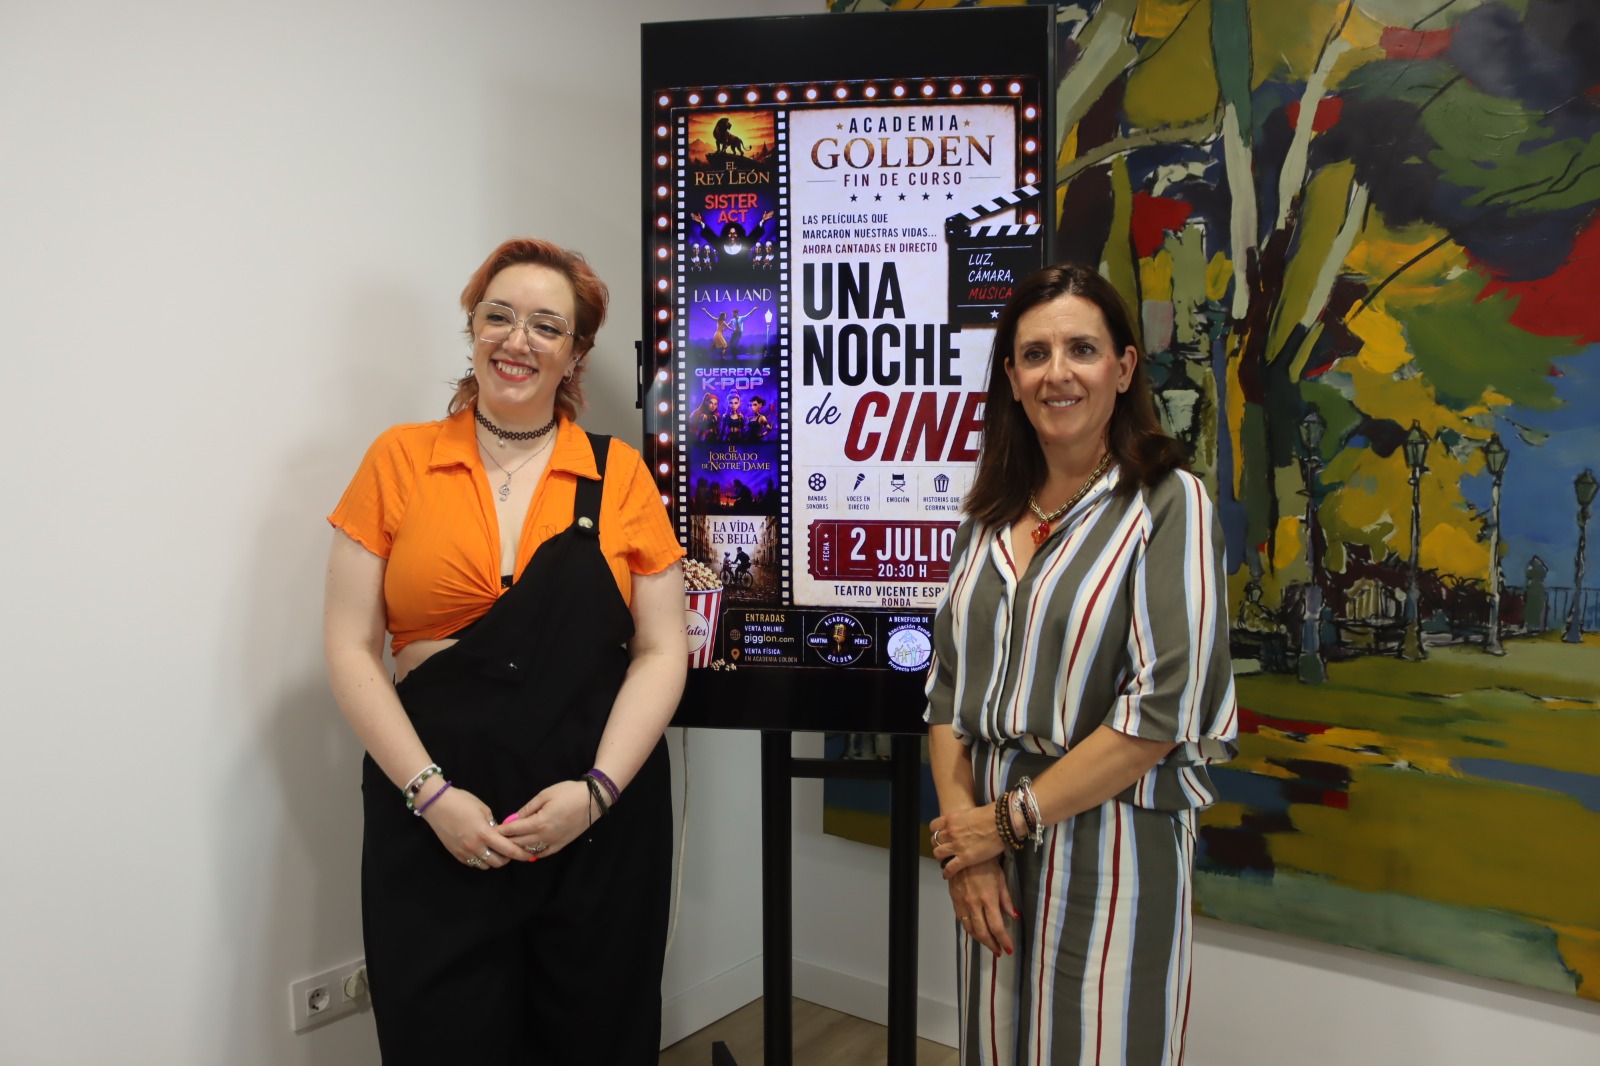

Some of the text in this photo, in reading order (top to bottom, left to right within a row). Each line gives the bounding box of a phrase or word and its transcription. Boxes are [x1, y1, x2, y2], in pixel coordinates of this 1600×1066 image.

[849, 114, 959, 133] ACADEMIA
[810, 134, 995, 170] GOLDEN
[726, 162, 737, 170] EL
[694, 168, 770, 185] REY LEÓN
[844, 172, 962, 187] FIN DE CURSO
[705, 193, 758, 209] SISTER
[718, 209, 748, 224] ACT
[802, 213, 888, 224] LAS PELÍCULAS QUE
[802, 228, 936, 239] MARCARON NUESTRAS VIDAS...
[802, 242, 937, 254] AHORA CANTADAS EN DIRECTO
[969, 253, 993, 266] LUZ,
[968, 267, 1014, 283] CÁMARA,
[694, 288, 772, 302] LA LA LAND
[803, 262, 906, 320] UNA
[968, 284, 1013, 300] MÚSICA
[803, 323, 962, 386] NOCHE
[695, 368, 770, 377] GUERRERAS
[702, 377, 763, 390] K-POP
[805, 390, 988, 462] de CINE
[710, 451, 758, 461] JOROBADO
[710, 461, 740, 470] NOTRE
[743, 462, 770, 471] DAME
[714, 522, 726, 532] LA
[713, 534, 758, 544] ES BELLA
[850, 527, 957, 562] 2 JULIO
[878, 564, 927, 578] 20:30 H
[834, 585, 872, 596] TEATRO
[876, 586, 918, 597] VICENTE
[881, 598, 911, 606] RONDA
[746, 613, 785, 622] ENTRADAS
[824, 617, 855, 628] ACADEMIA
[827, 654, 852, 662] GOLDEN
[888, 660, 930, 672] Proyecto Hombre
